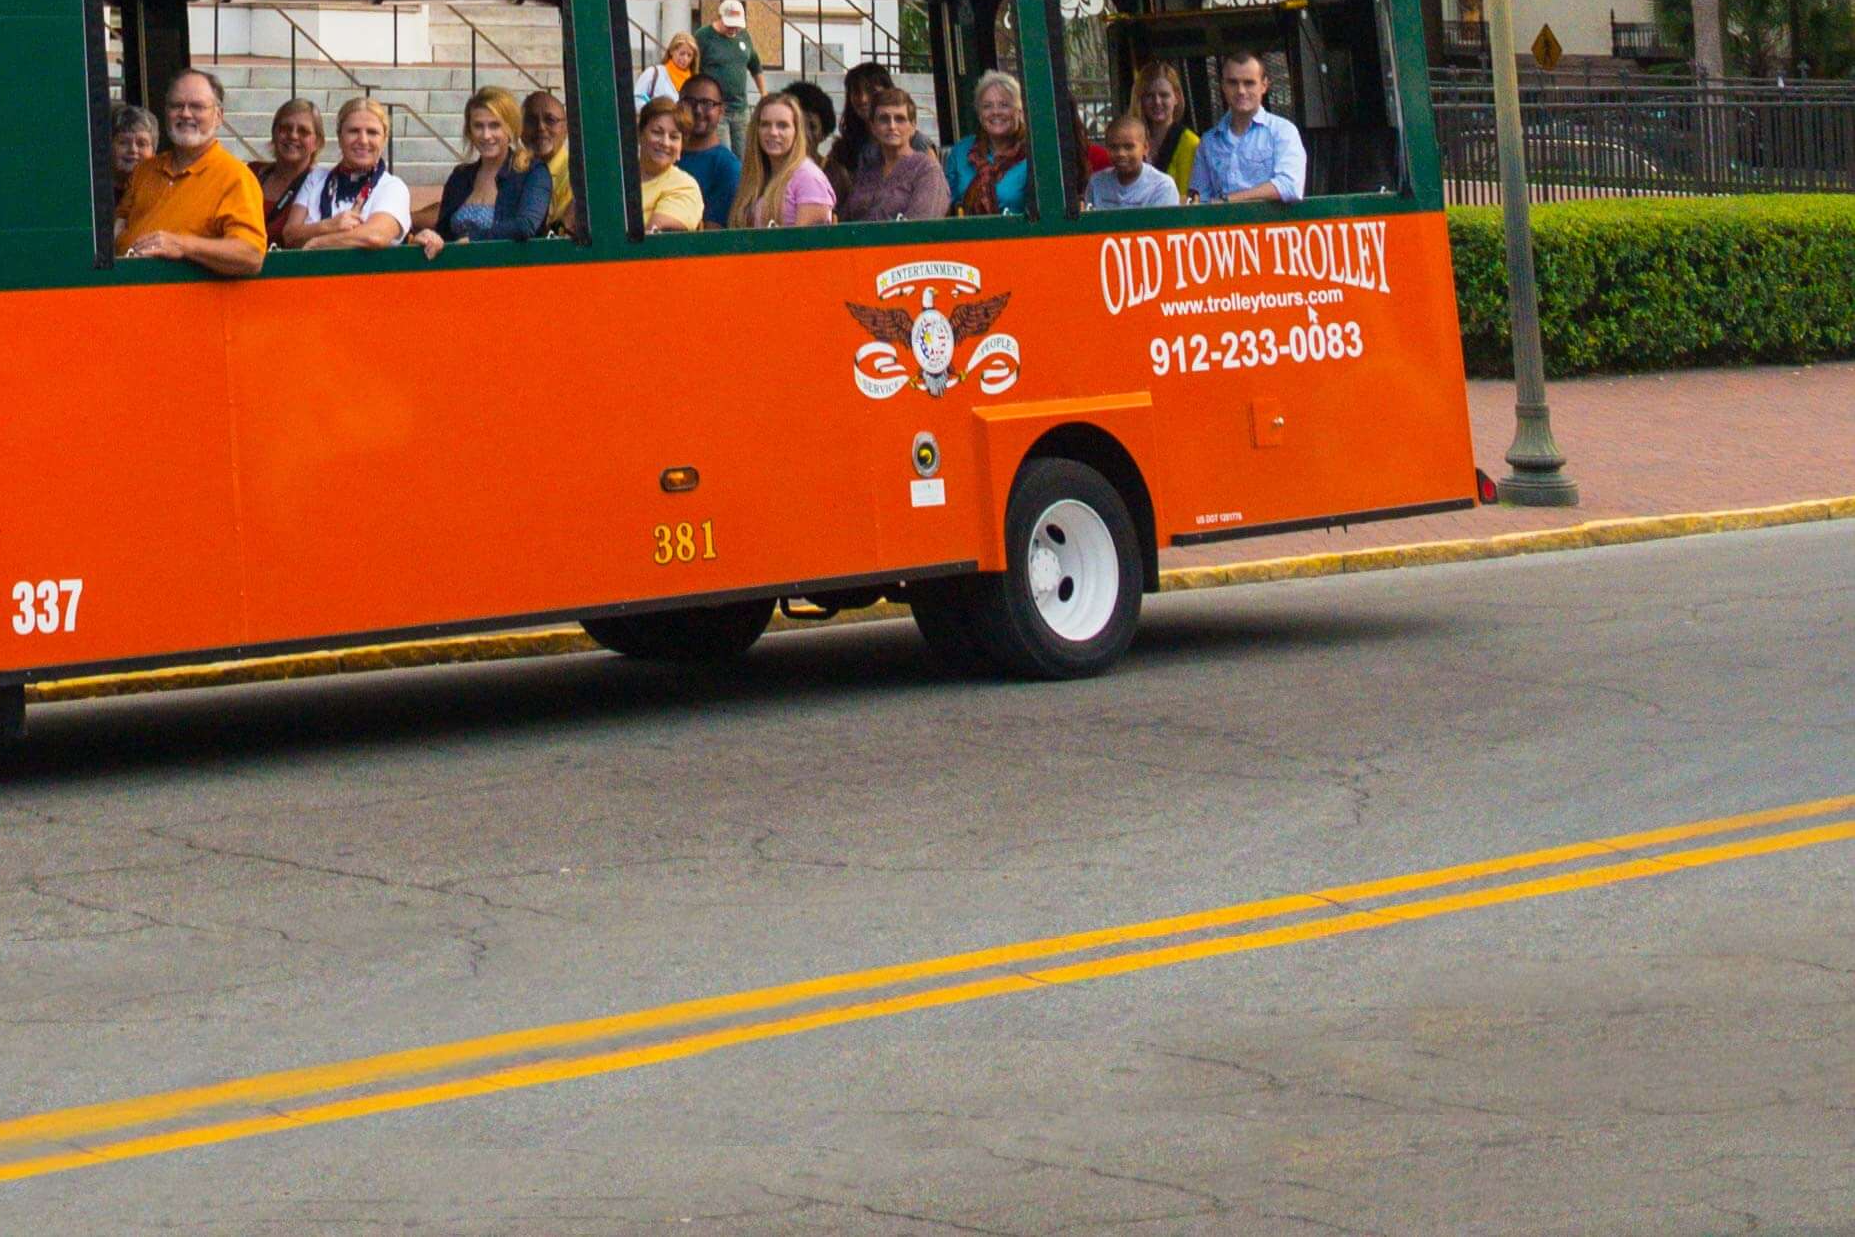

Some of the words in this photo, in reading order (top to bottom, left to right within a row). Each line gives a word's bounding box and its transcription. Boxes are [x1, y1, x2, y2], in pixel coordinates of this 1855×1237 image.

[891, 265, 964, 284] ENTERTAINMENT
[1100, 236, 1163, 315] OLD
[1166, 228, 1261, 290] TOWN
[1266, 221, 1390, 293] TROLLEY
[1160, 288, 1343, 316] www.trolleytours.com
[980, 335, 1012, 355] PEOPLE
[1149, 321, 1363, 376] 912-233-0083
[863, 380, 900, 395] SERVICE
[653, 519, 717, 564] 381
[12, 578, 83, 636] 337
